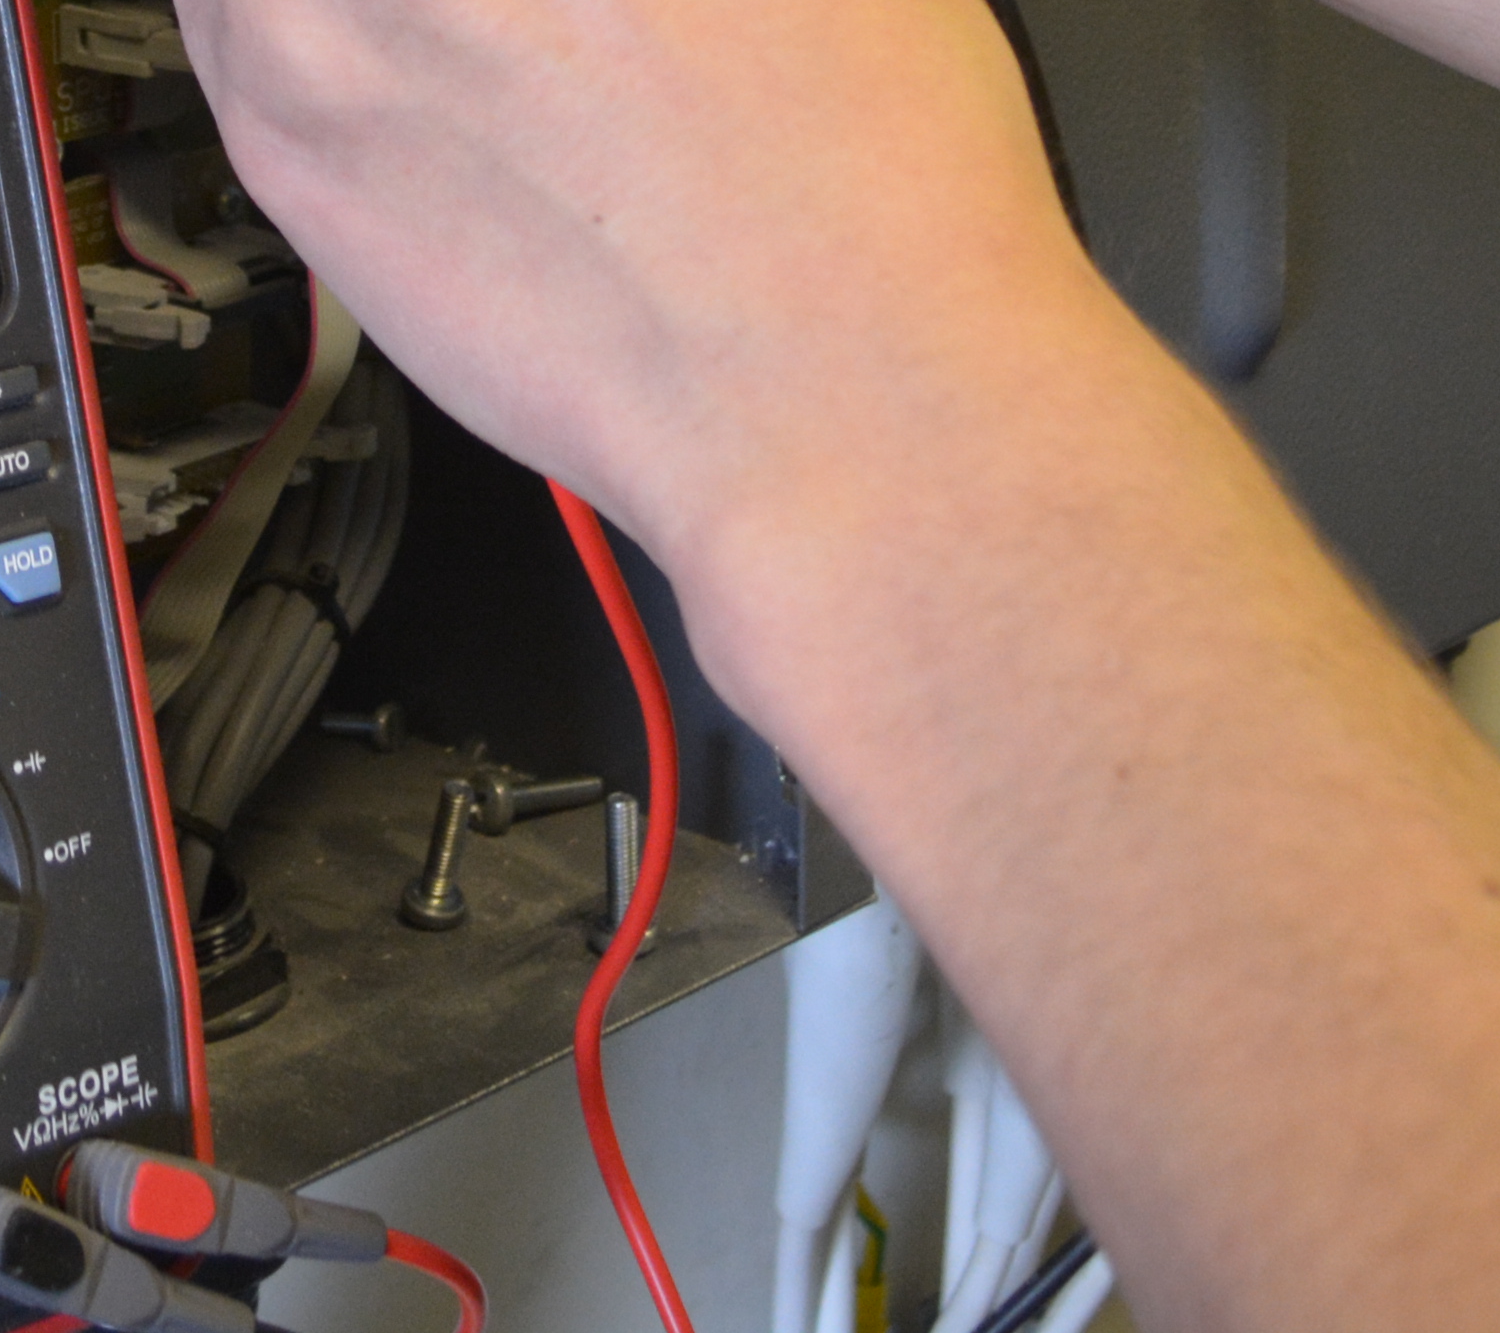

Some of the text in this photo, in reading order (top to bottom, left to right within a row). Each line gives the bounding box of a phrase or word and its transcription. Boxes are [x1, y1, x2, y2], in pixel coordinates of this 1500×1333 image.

[2, 546, 53, 575] HOLD
[54, 832, 92, 864] OFF
[38, 1055, 140, 1115] SCOPE
